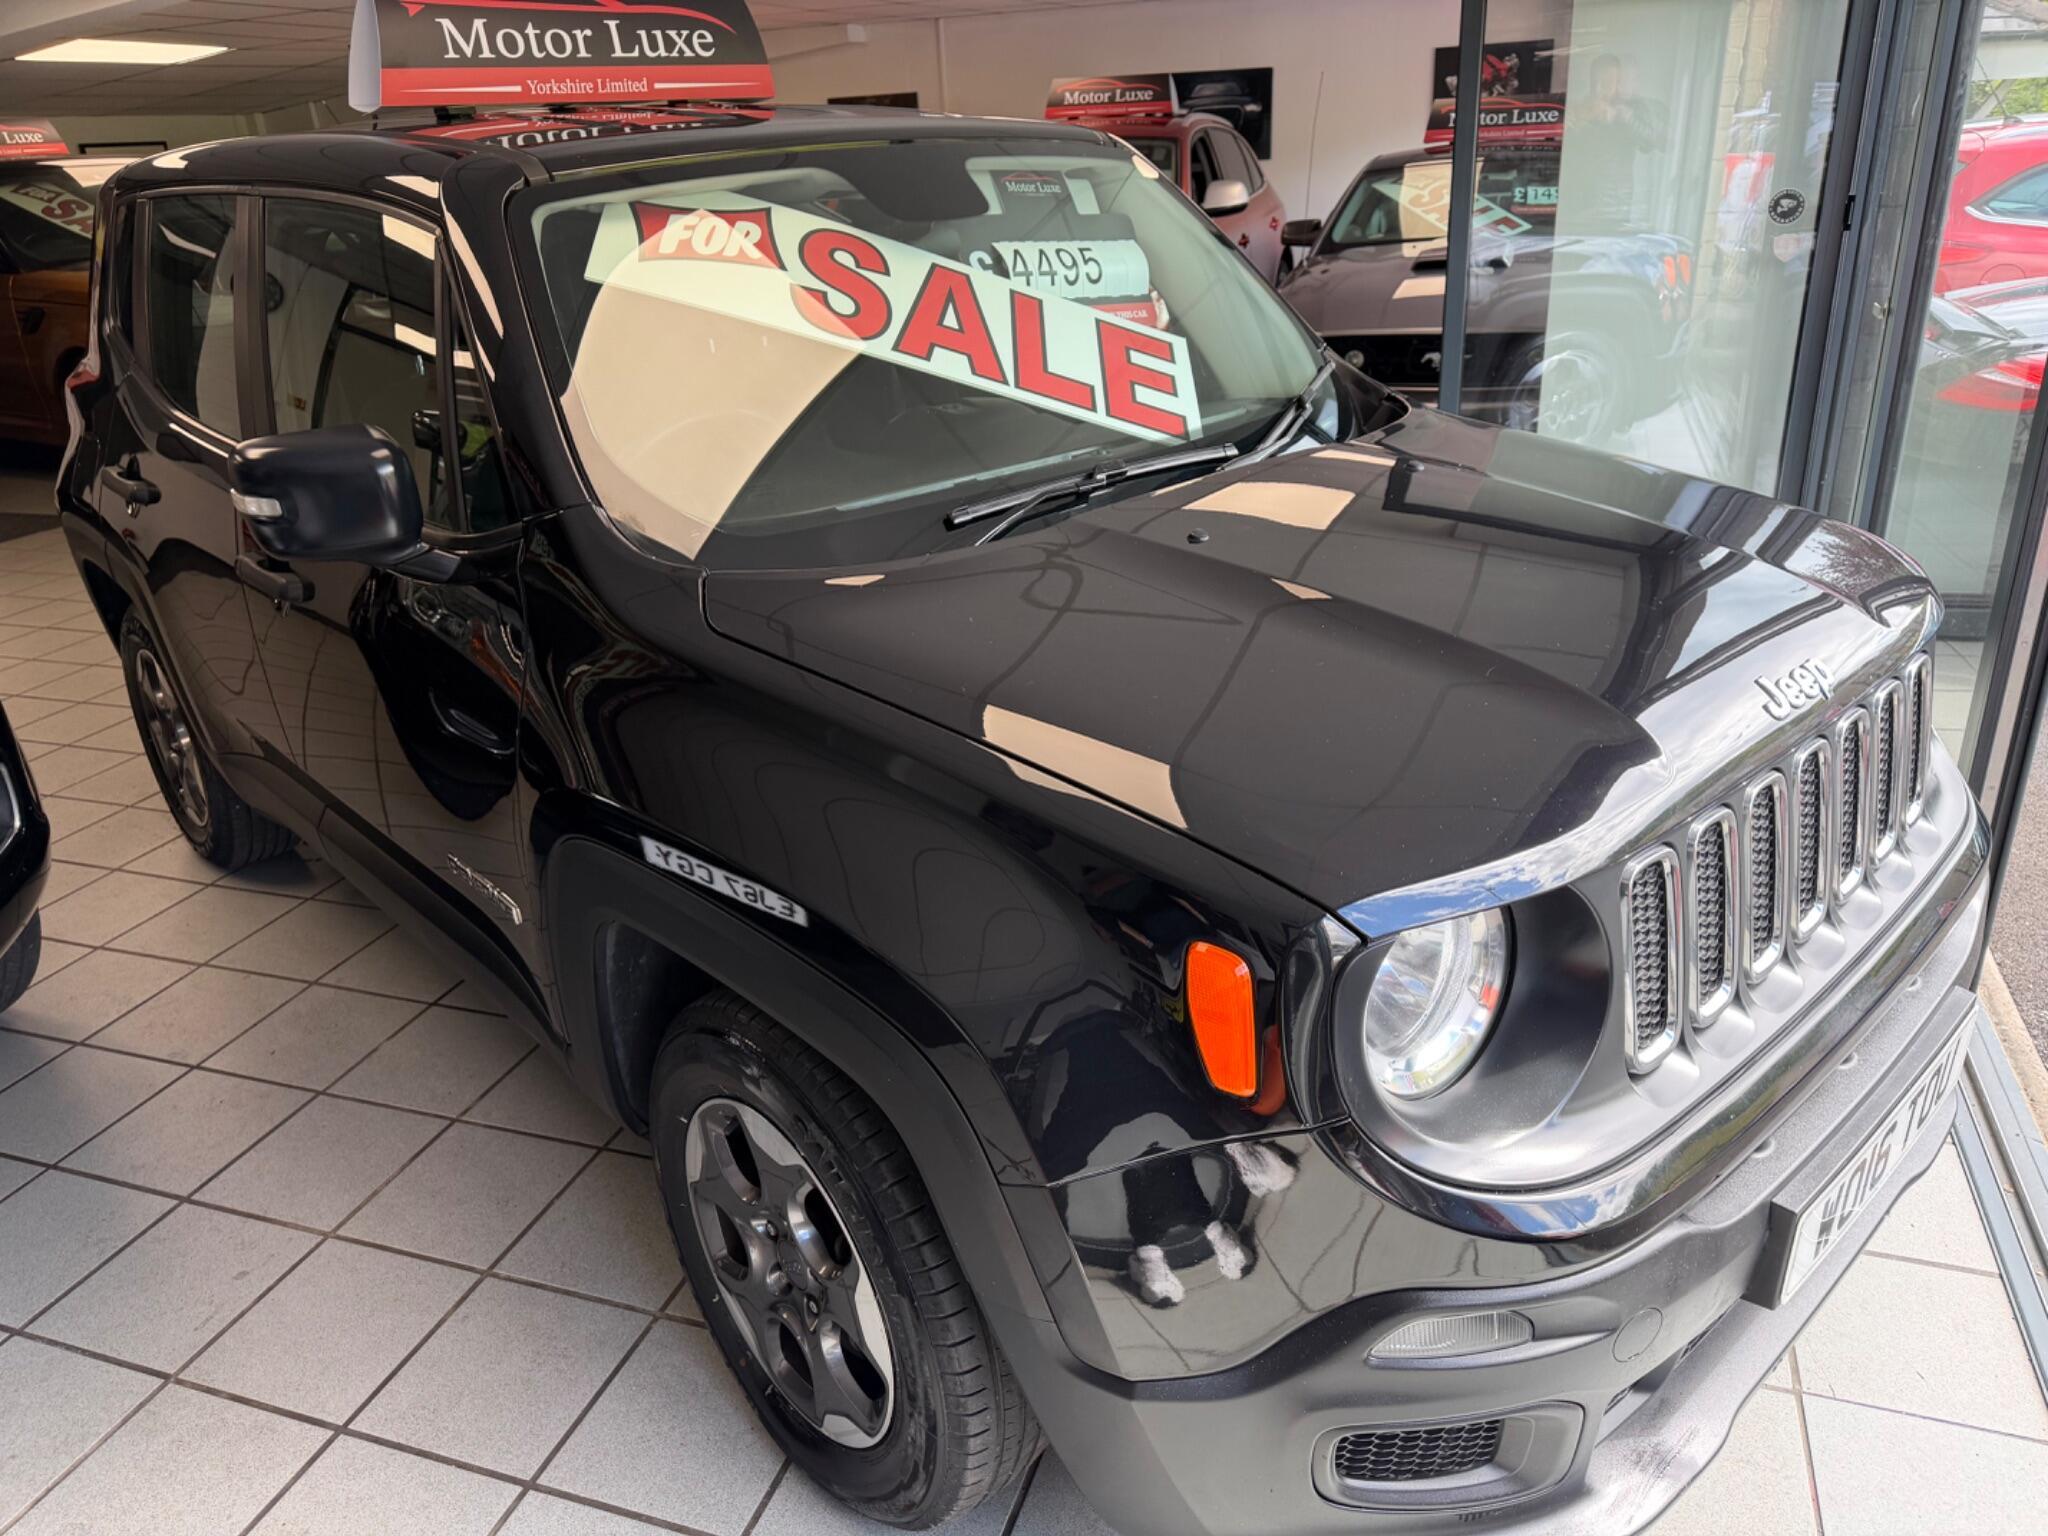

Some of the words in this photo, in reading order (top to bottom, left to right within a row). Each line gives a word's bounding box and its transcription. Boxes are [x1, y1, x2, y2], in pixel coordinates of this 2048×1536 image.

[435, 18, 593, 60] Motor
[604, 19, 716, 59] Luxe
[526, 80, 595, 96] Yorkshire
[597, 77, 648, 94] Limited
[1063, 90, 1111, 106] Motor
[1114, 88, 1154, 103] Luxe
[1511, 108, 1560, 125] Luxe
[2, 131, 45, 145] Luxe
[657, 212, 763, 261] FOR
[790, 228, 1190, 441] SALE
[1753, 658, 1836, 722] Jeep
